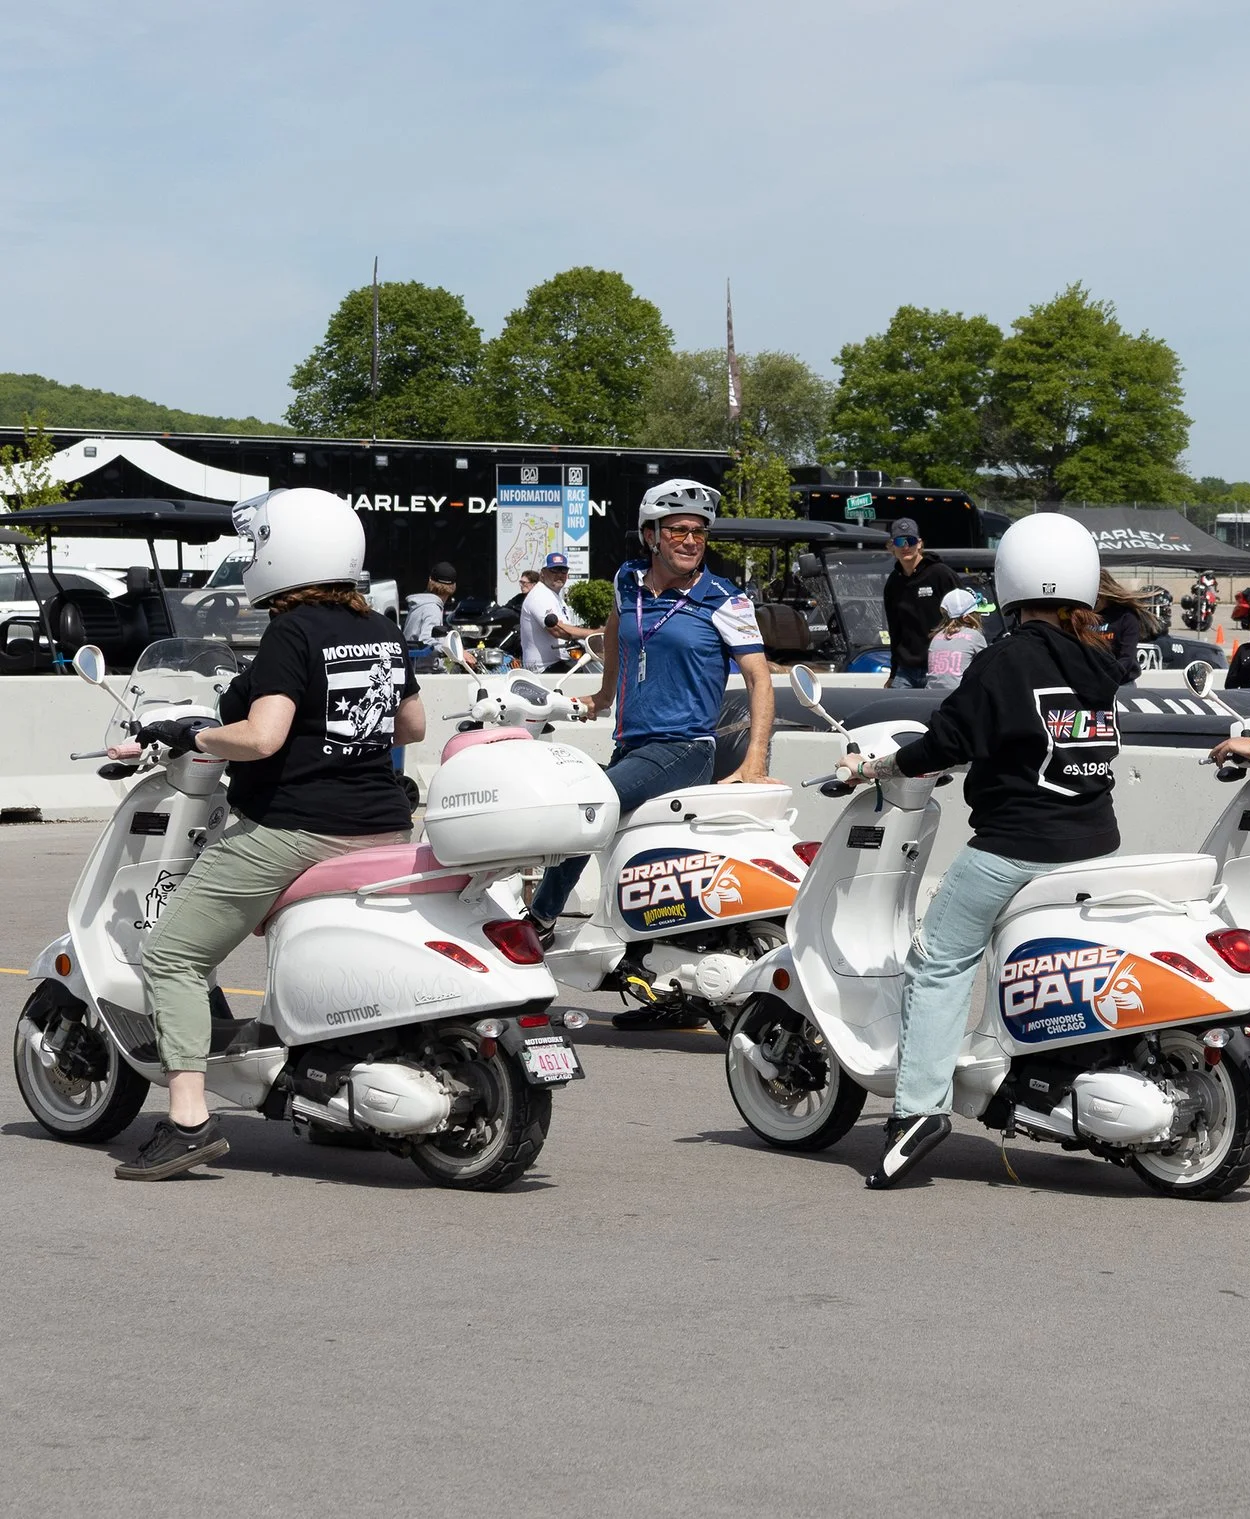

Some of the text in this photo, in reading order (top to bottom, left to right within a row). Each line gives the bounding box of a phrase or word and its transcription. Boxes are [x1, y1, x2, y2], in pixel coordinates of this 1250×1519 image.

[500, 489, 560, 502] INFORMATION
[567, 490, 585, 501] RACE
[569, 503, 583, 515] DAY
[567, 519, 585, 528] INFO
[323, 642, 402, 661] MOTOWORKS
[441, 789, 499, 809] CATTITUDE
[619, 852, 722, 884] ORANGE
[622, 868, 715, 911] CAT
[643, 902, 687, 926] MOTOWORKS
[1000, 947, 1121, 983] ORANGE
[1004, 966, 1111, 1017] CAT
[326, 1004, 382, 1026] CATTITUDE
[1028, 1013, 1085, 1032] MOTOWORKS
[1046, 1021, 1087, 1035] CHICAGO
[524, 1036, 563, 1046] MOTOWORKS
